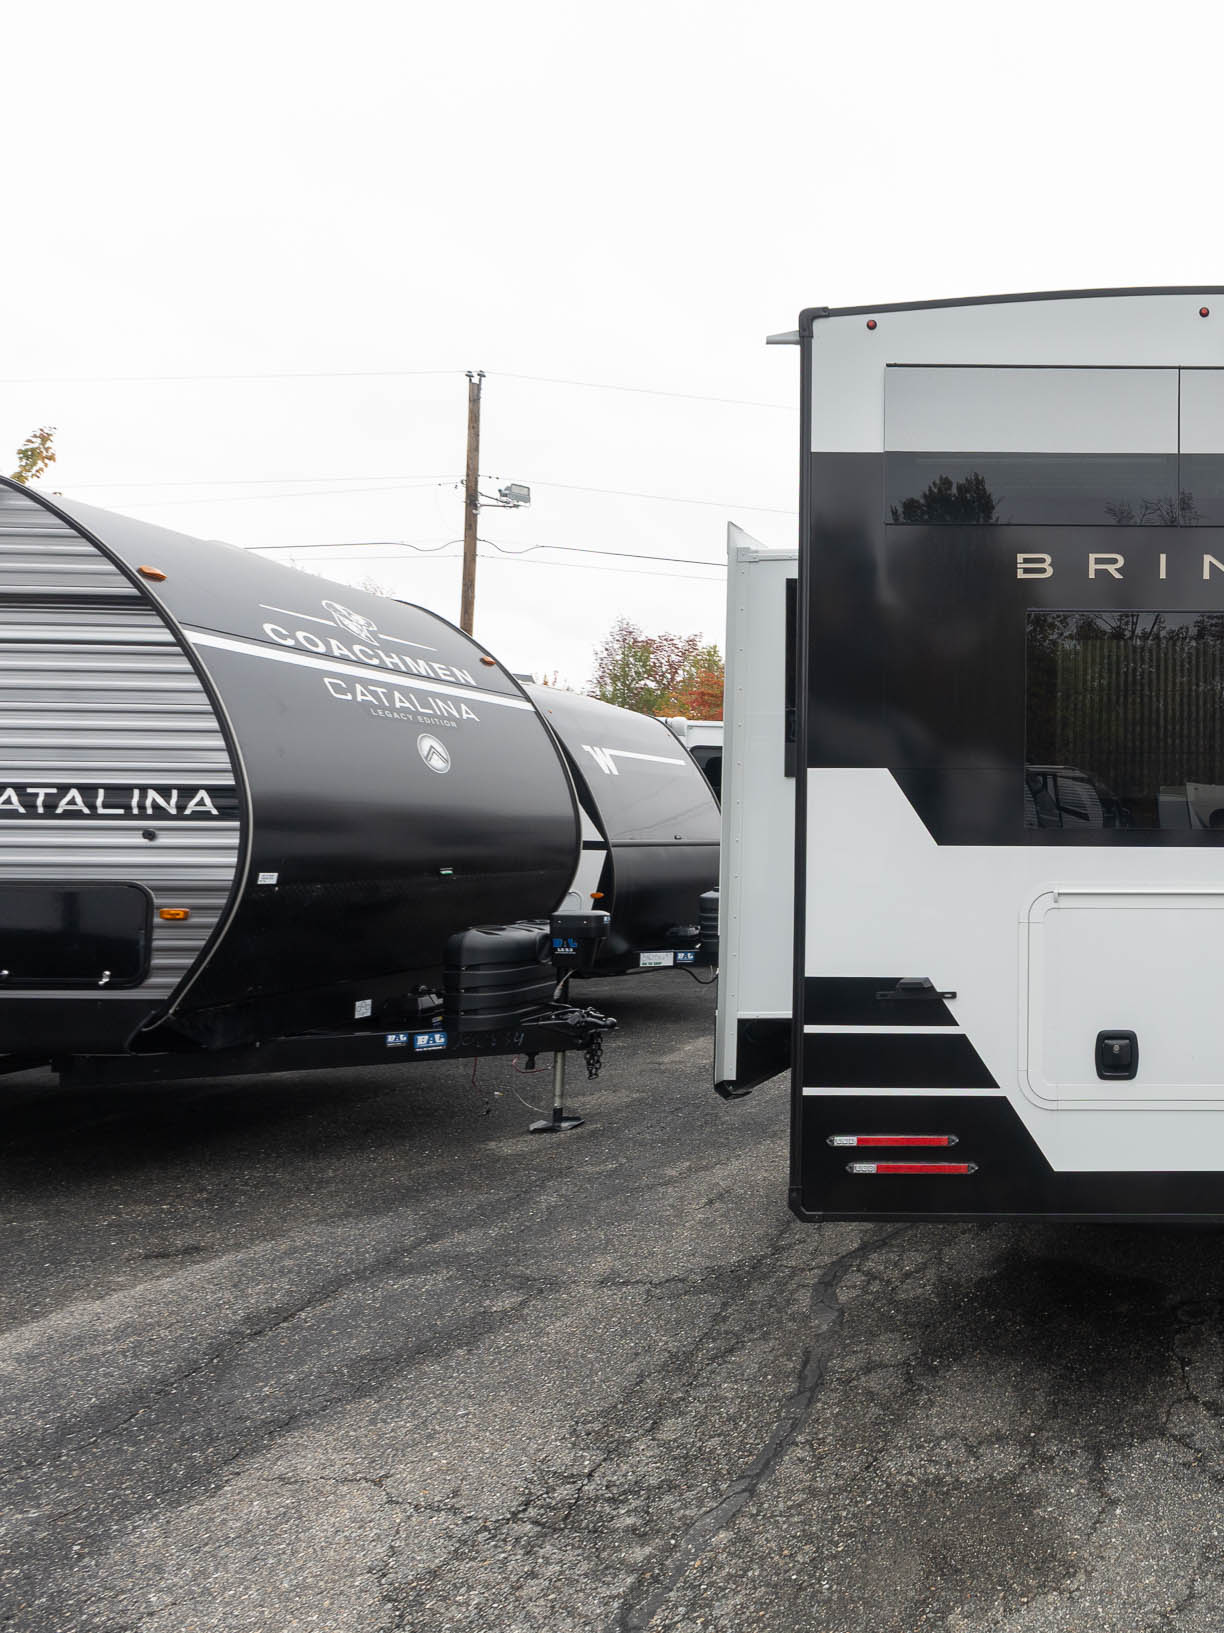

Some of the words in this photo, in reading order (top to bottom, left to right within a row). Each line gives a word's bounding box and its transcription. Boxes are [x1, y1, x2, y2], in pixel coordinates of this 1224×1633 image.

[262, 623, 477, 686] COACHMEN
[323, 677, 481, 722] CATALINA
[371, 707, 414, 721] LEGACY
[417, 716, 458, 728] EDITION
[0, 787, 220, 815] ATALINA
